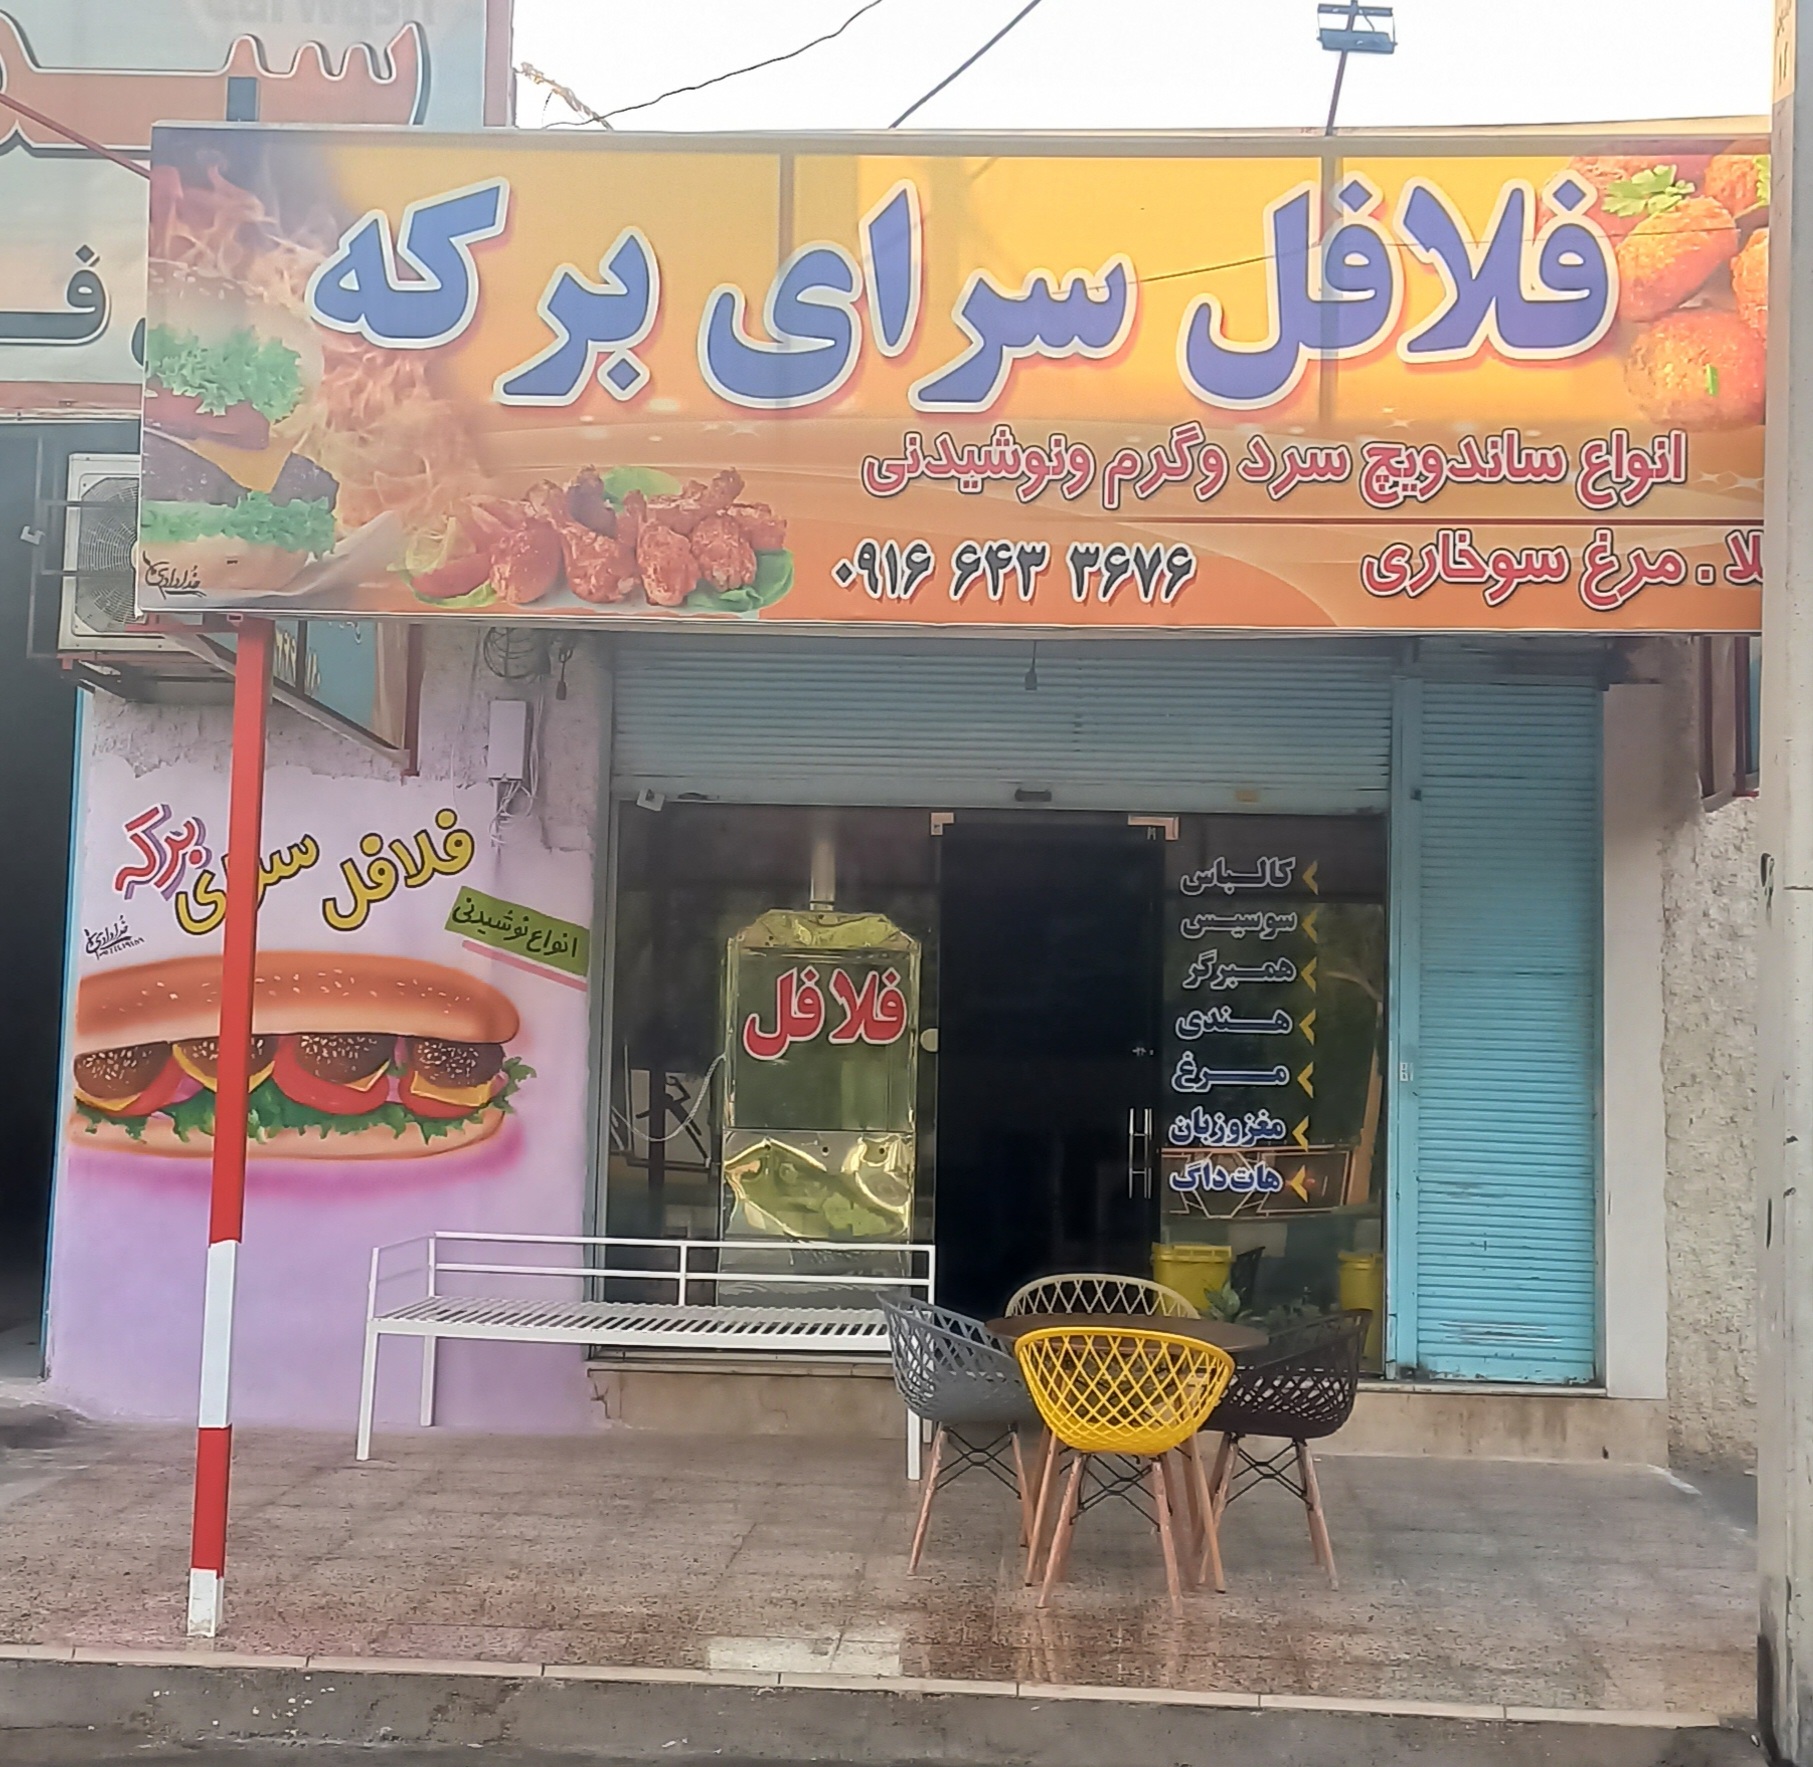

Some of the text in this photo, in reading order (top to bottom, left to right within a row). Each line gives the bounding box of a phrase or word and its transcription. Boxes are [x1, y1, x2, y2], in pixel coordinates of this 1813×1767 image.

[305, 177, 660, 407] برکه
[698, 178, 1137, 413] سرای
[1177, 170, 1620, 410] فلافل
[1236, 434, 1352, 501] سرد
[1360, 428, 1568, 508] ساندویچ
[1577, 428, 1688, 509] انواع
[1361, 528, 1571, 607] سوخاری
[1578, 527, 1688, 612] مرغ
[321, 808, 475, 932] فلافل
[1180, 856, 1296, 896] کالباس
[452, 897, 578, 958] انواع نوشیدنی
[1180, 911, 1298, 940] سوسیس
[1182, 949, 1297, 990] همبرگر
[743, 965, 908, 1061] فلافل
[1175, 1006, 1293, 1040] هندی
[1172, 1051, 1290, 1092] مرغ
